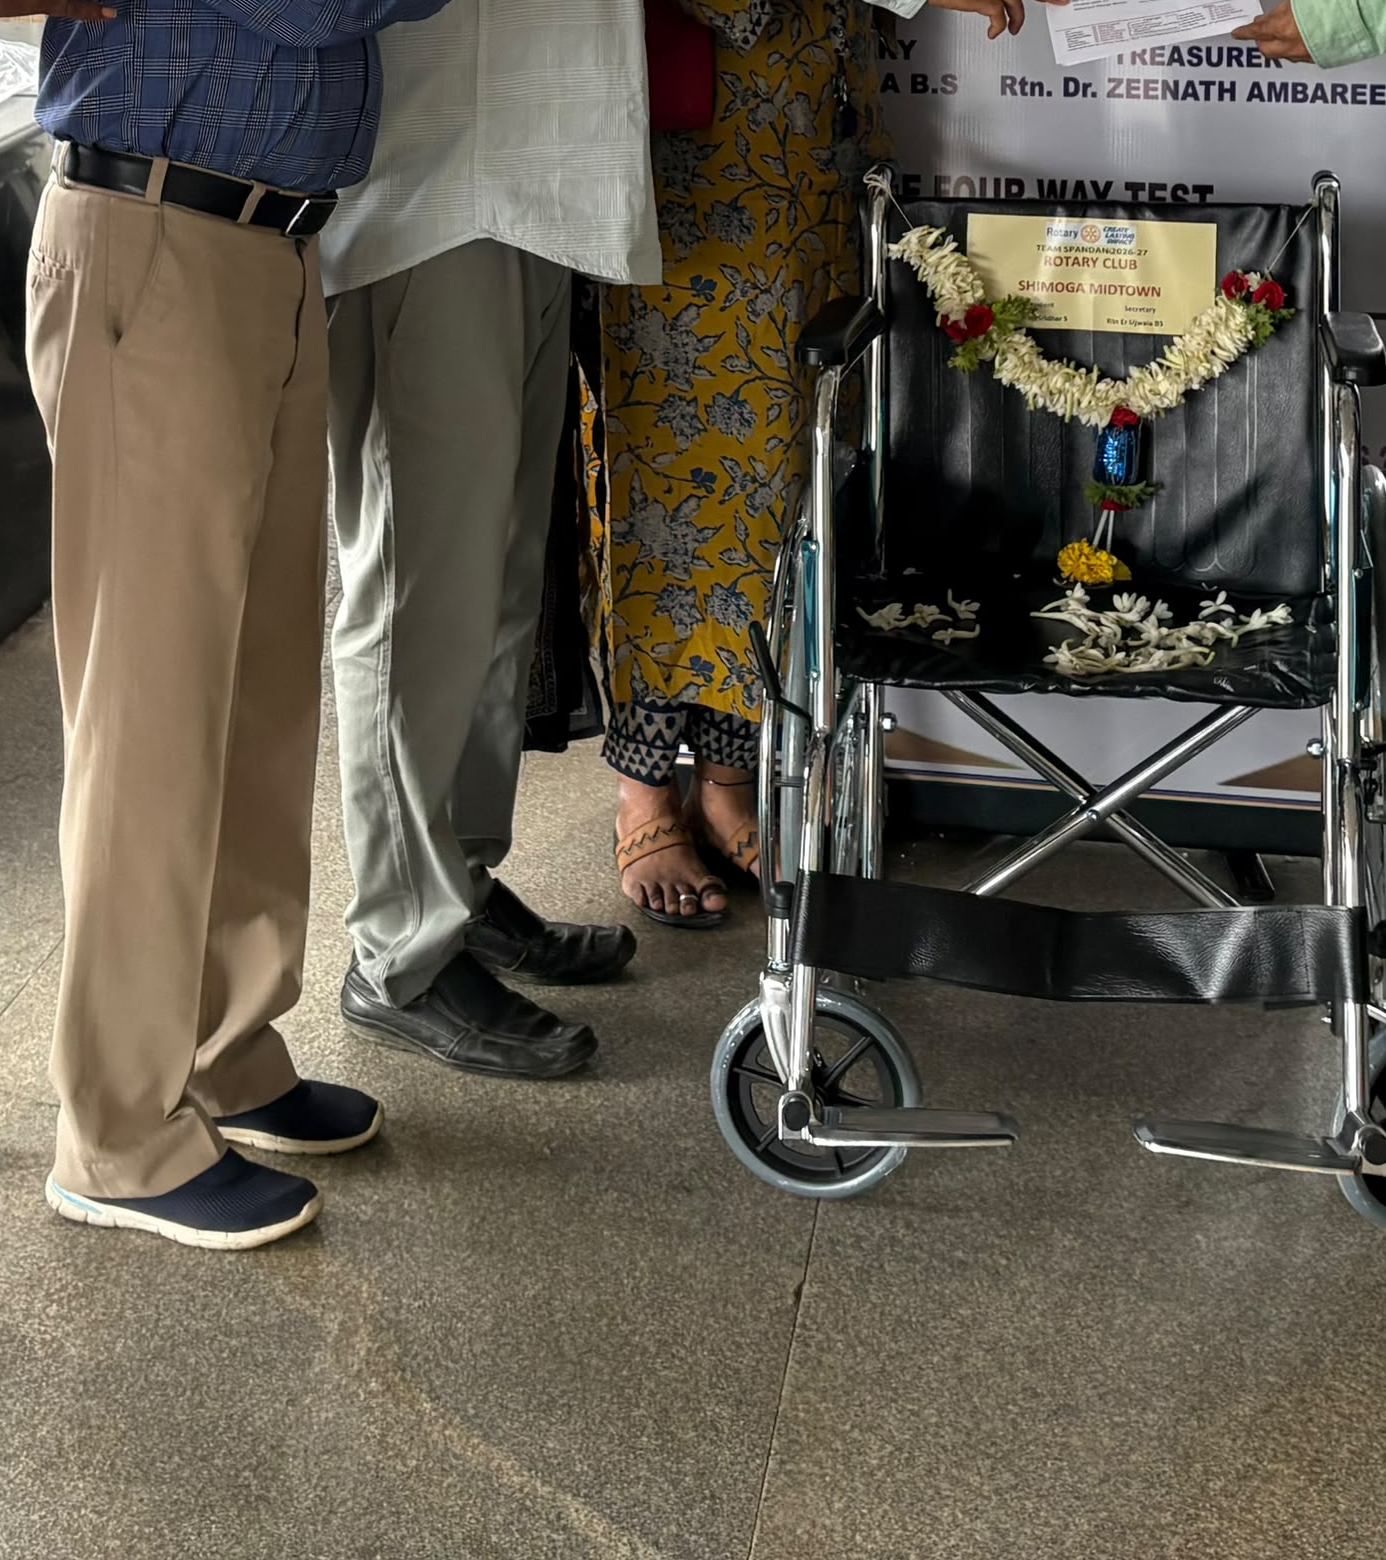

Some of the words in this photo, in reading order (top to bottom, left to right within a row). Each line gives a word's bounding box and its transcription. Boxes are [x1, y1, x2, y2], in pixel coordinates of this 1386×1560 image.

[910, 73, 959, 96] B.S
[1000, 74, 1053, 98] Rtn.
[1063, 76, 1098, 99] Dr.
[1106, 77, 1237, 102] ZEENATH
[1046, 227, 1079, 240] Rotary
[1044, 256, 1099, 268] ROTARY
[1102, 257, 1138, 270] CLUB
[1018, 280, 1086, 295] SHIMOGA
[1089, 283, 1162, 298] MIDTOWN
